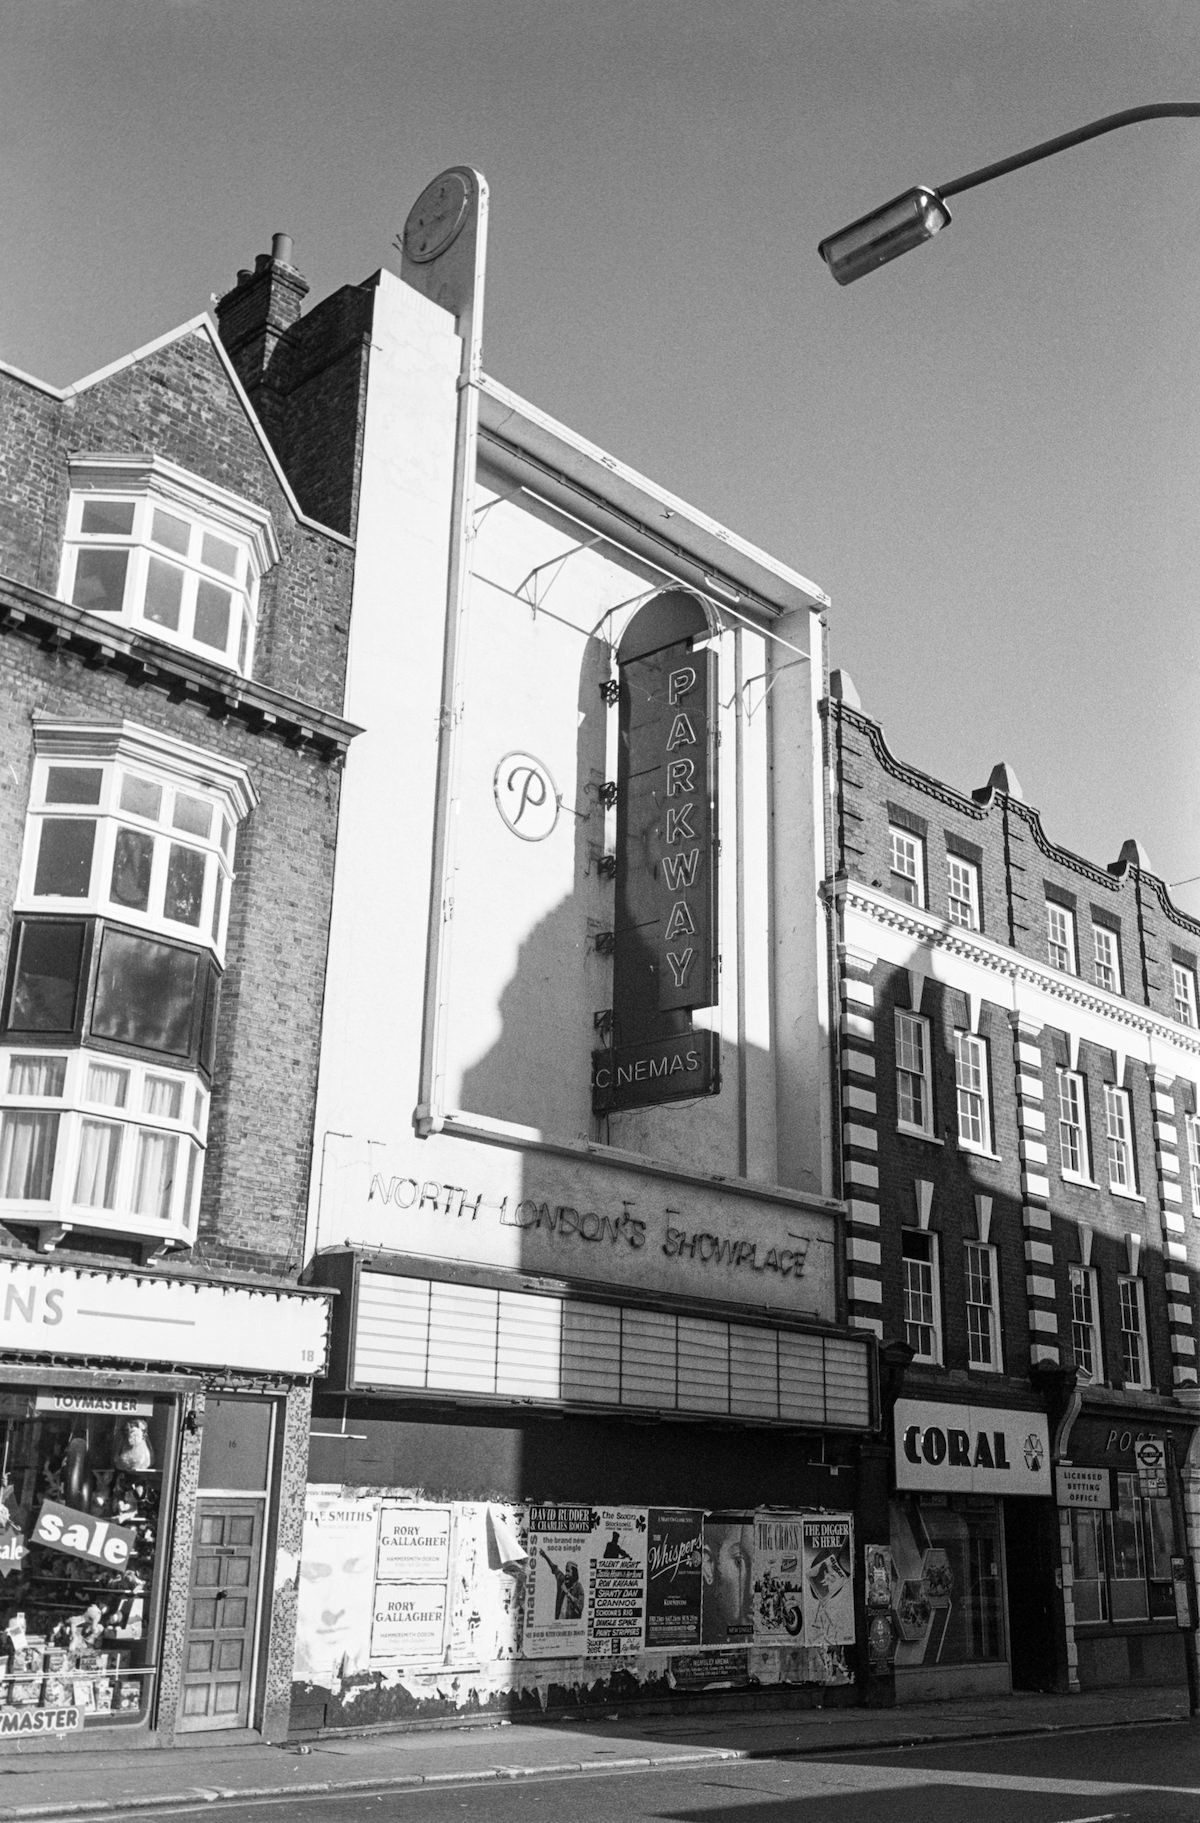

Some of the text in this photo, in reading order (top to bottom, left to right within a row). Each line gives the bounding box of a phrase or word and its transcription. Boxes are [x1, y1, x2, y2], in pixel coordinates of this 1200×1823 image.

[662, 666, 698, 986] PARKWAY
[596, 1050, 698, 1088] CNEMAS
[368, 1172, 483, 1220] NORTH
[661, 1224, 808, 1279] SHOWPLACE
[3, 1283, 65, 1326] NS
[301, 1349, 315, 1362] 18
[54, 1394, 138, 1412] TOYMASTER
[229, 1440, 237, 1449] 16
[903, 1424, 1011, 1470] CORAL
[1063, 1472, 1103, 1481] LICENSED
[1067, 1482, 1100, 1491] BETTING
[1069, 1494, 1098, 1502] OFFICE
[328, 1511, 373, 1522] SMITHS
[531, 1508, 590, 1522] DAVID RUDDER
[393, 1526, 421, 1536] RORY
[537, 1521, 568, 1531] CHARLIES
[569, 1521, 590, 1531] ROOTS
[804, 1523, 849, 1536] THE DIGGER
[38, 1514, 128, 1564] sale
[381, 1536, 447, 1547] GALLAGHER
[758, 1523, 799, 1551] THE CROSS
[812, 1536, 820, 1548] IS
[0, 1537, 24, 1560] ale
[563, 1544, 581, 1552] single
[648, 1532, 702, 1583] Whispers
[598, 1560, 641, 1569] TALENT NIGHT
[526, 1534, 538, 1628] madness
[387, 1601, 415, 1612] RORY
[596, 1599, 637, 1607] CRANNOG
[375, 1611, 442, 1623] GALLAGHER
[0, 1707, 78, 1733] MASTER
